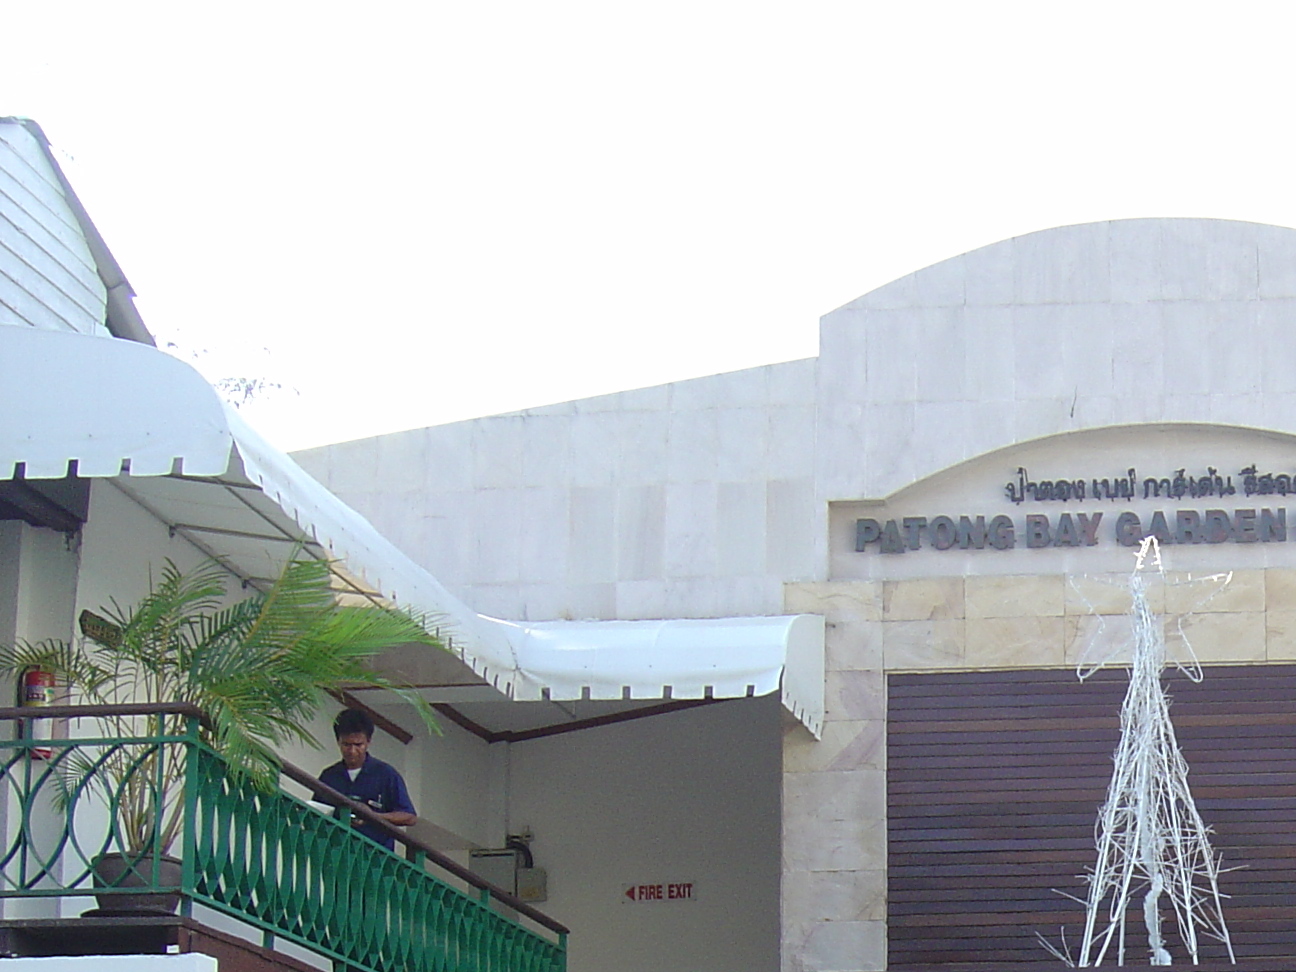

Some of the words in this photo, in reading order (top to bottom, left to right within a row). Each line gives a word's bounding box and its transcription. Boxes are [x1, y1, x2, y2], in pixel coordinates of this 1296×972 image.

[855, 514, 1015, 556] PATONG
[1026, 511, 1104, 549] BAY
[1116, 506, 1288, 548] GARDEN
[638, 884, 663, 900] FIRE
[668, 883, 693, 899] EXIT
